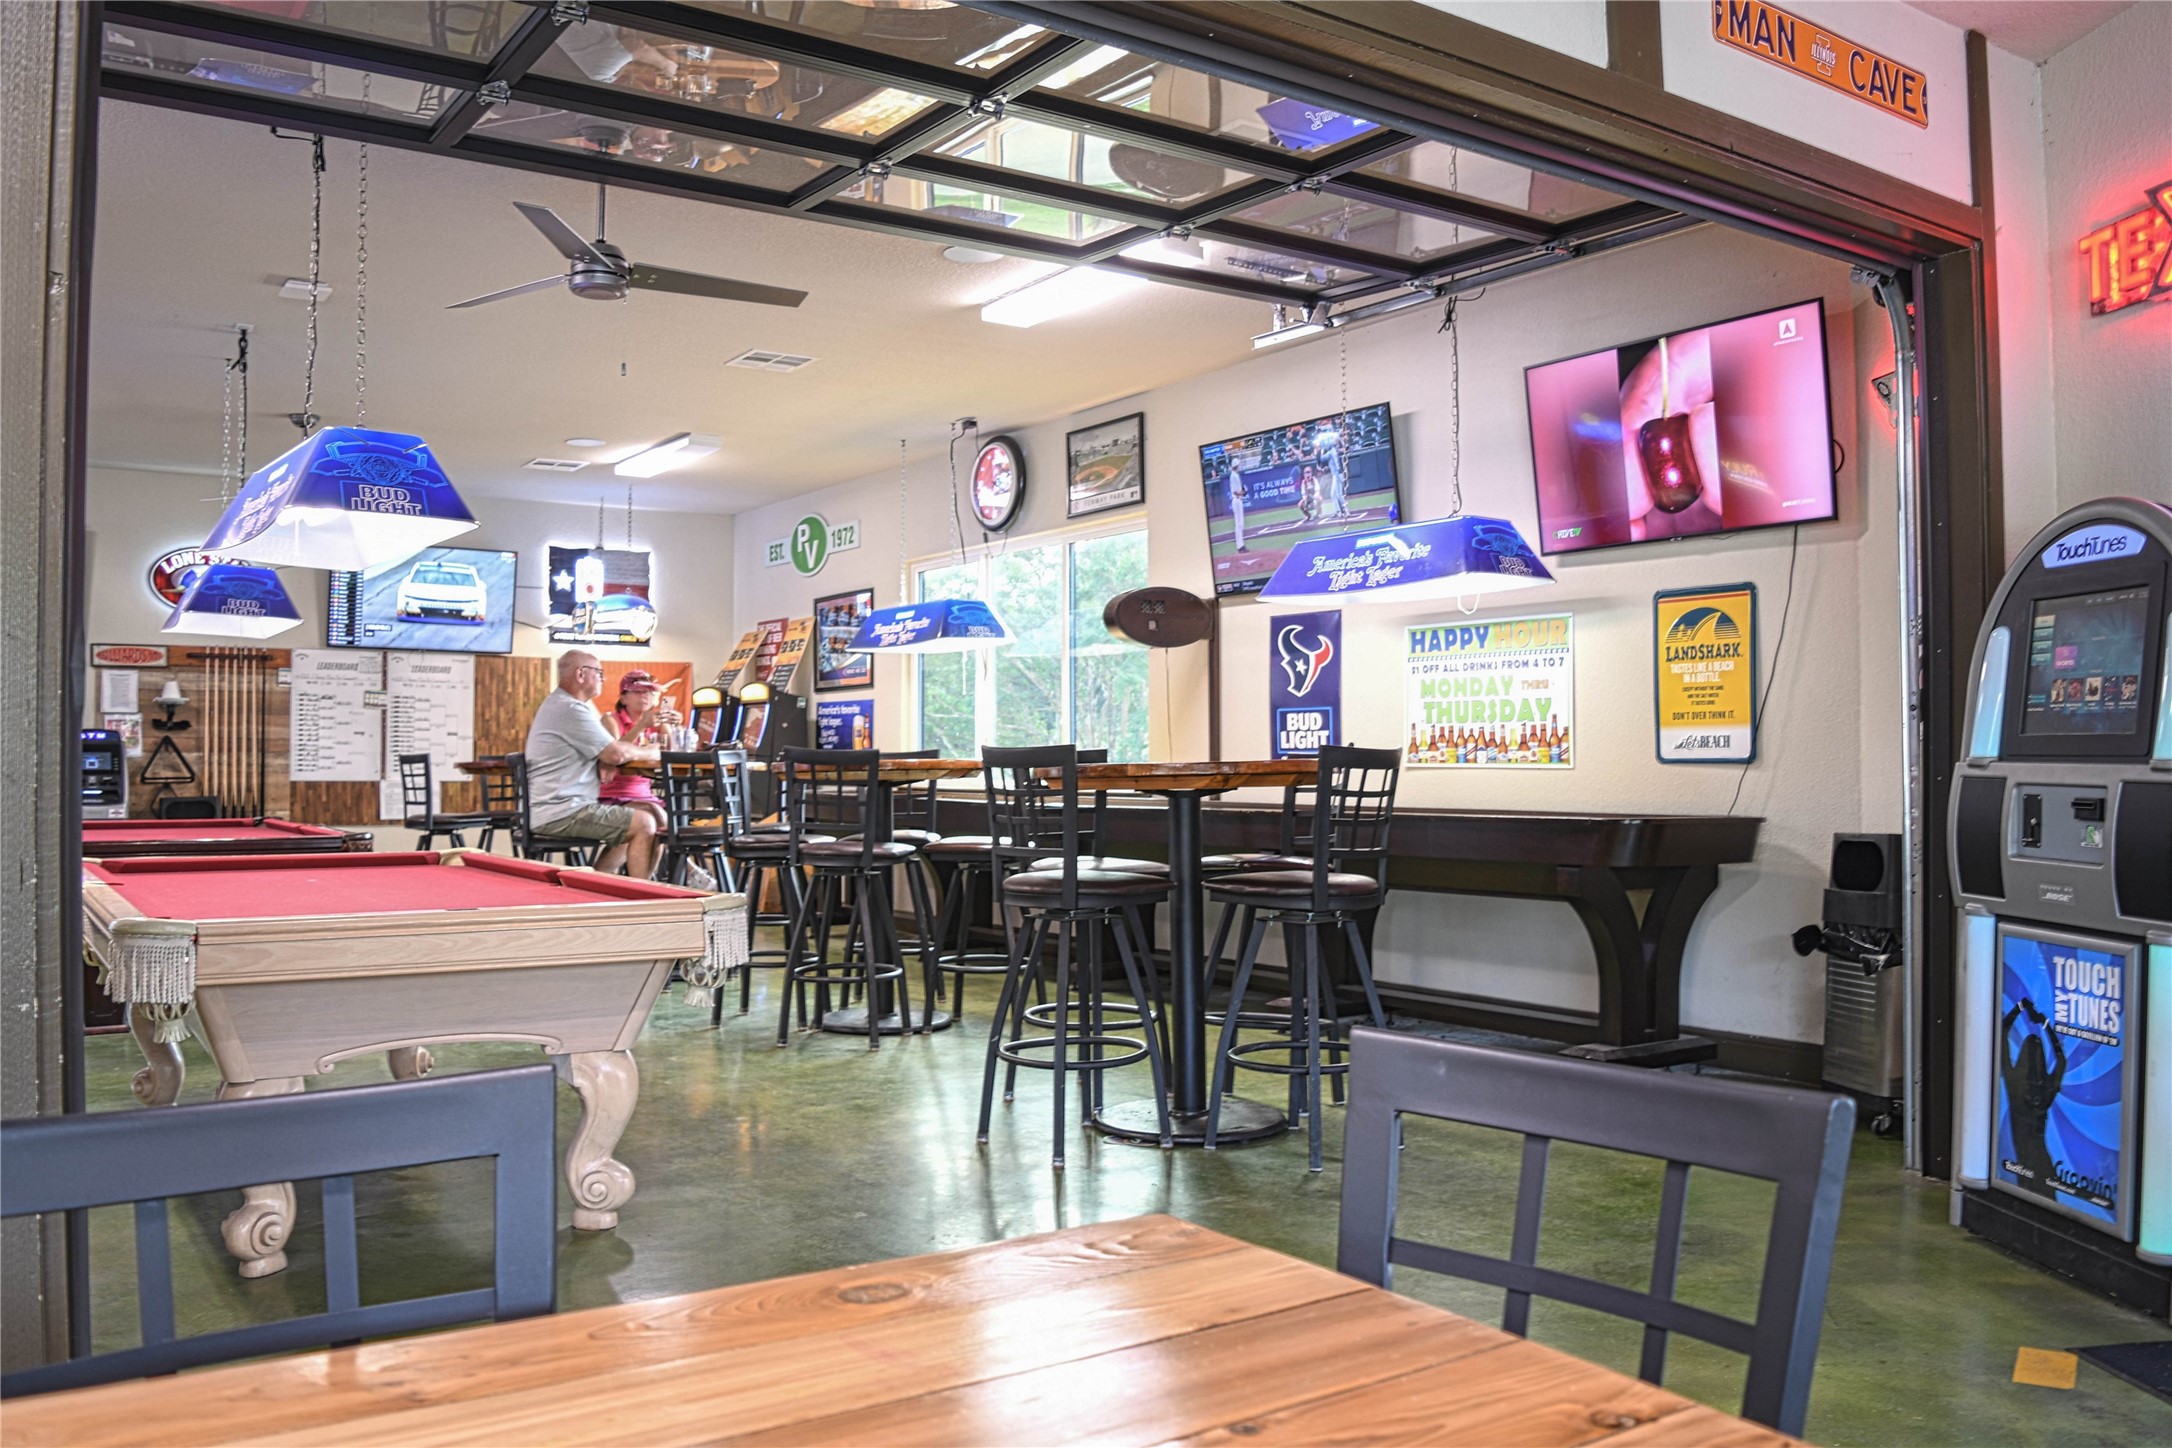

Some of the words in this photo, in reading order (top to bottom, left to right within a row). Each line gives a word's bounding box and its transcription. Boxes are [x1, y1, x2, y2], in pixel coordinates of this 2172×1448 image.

[1728, 0, 1796, 64] MAN
[1810, 43, 1837, 66] ILLINOIS
[1848, 49, 1918, 115] CAVE
[359, 484, 411, 502] BUD
[1253, 483, 1265, 491] IT'S
[1266, 477, 1294, 488] ALWAYS
[1253, 492, 1259, 500] A
[1259, 489, 1279, 499] GOOD
[1279, 486, 1296, 495] TIME
[1109, 491, 1125, 501] PARK
[351, 498, 422, 516] LIGHT
[769, 542, 785, 562] EST.
[831, 525, 855, 549] 1972
[2055, 536, 2128, 562] TouchTunes
[160, 551, 206, 575] LONE
[1307, 552, 1375, 577] America's
[1375, 541, 1433, 568] Favorite
[1499, 555, 1525, 567] BUD
[1328, 570, 1363, 592] Light
[1365, 564, 1403, 587] Lager
[227, 598, 261, 610] BUD
[1410, 626, 1490, 654] HAPPY
[1494, 619, 1567, 649] HOUR
[316, 662, 359, 671] LEADERBOARD
[411, 665, 452, 674] LEADERBOARD
[1412, 666, 1420, 674] $1
[1422, 664, 1439, 673] OFF
[1443, 663, 1459, 672] ALL
[1463, 661, 1498, 671] DRINKS
[1501, 659, 1529, 669] FROM
[1533, 658, 1539, 667] 4
[1543, 657, 1555, 667] TO
[1559, 657, 1565, 667] 7
[1670, 663, 1693, 673] TASTES
[1693, 662, 1707, 673] LIKE
[1420, 675, 1514, 699] MONDAY
[1521, 679, 1549, 691] THRU
[1423, 697, 1552, 724] THURSDAY
[1672, 712, 1690, 720] DON'T
[1691, 711, 1707, 720] OVER
[1708, 711, 1726, 719] THINK
[1286, 712, 1323, 731] BUD
[1280, 730, 1330, 750] LIGHT
[1699, 735, 1731, 749] BEACH
[2053, 955, 2122, 1000] TOUCH
[2054, 989, 2068, 1023] MY
[2067, 992, 2120, 1034] TUNES
